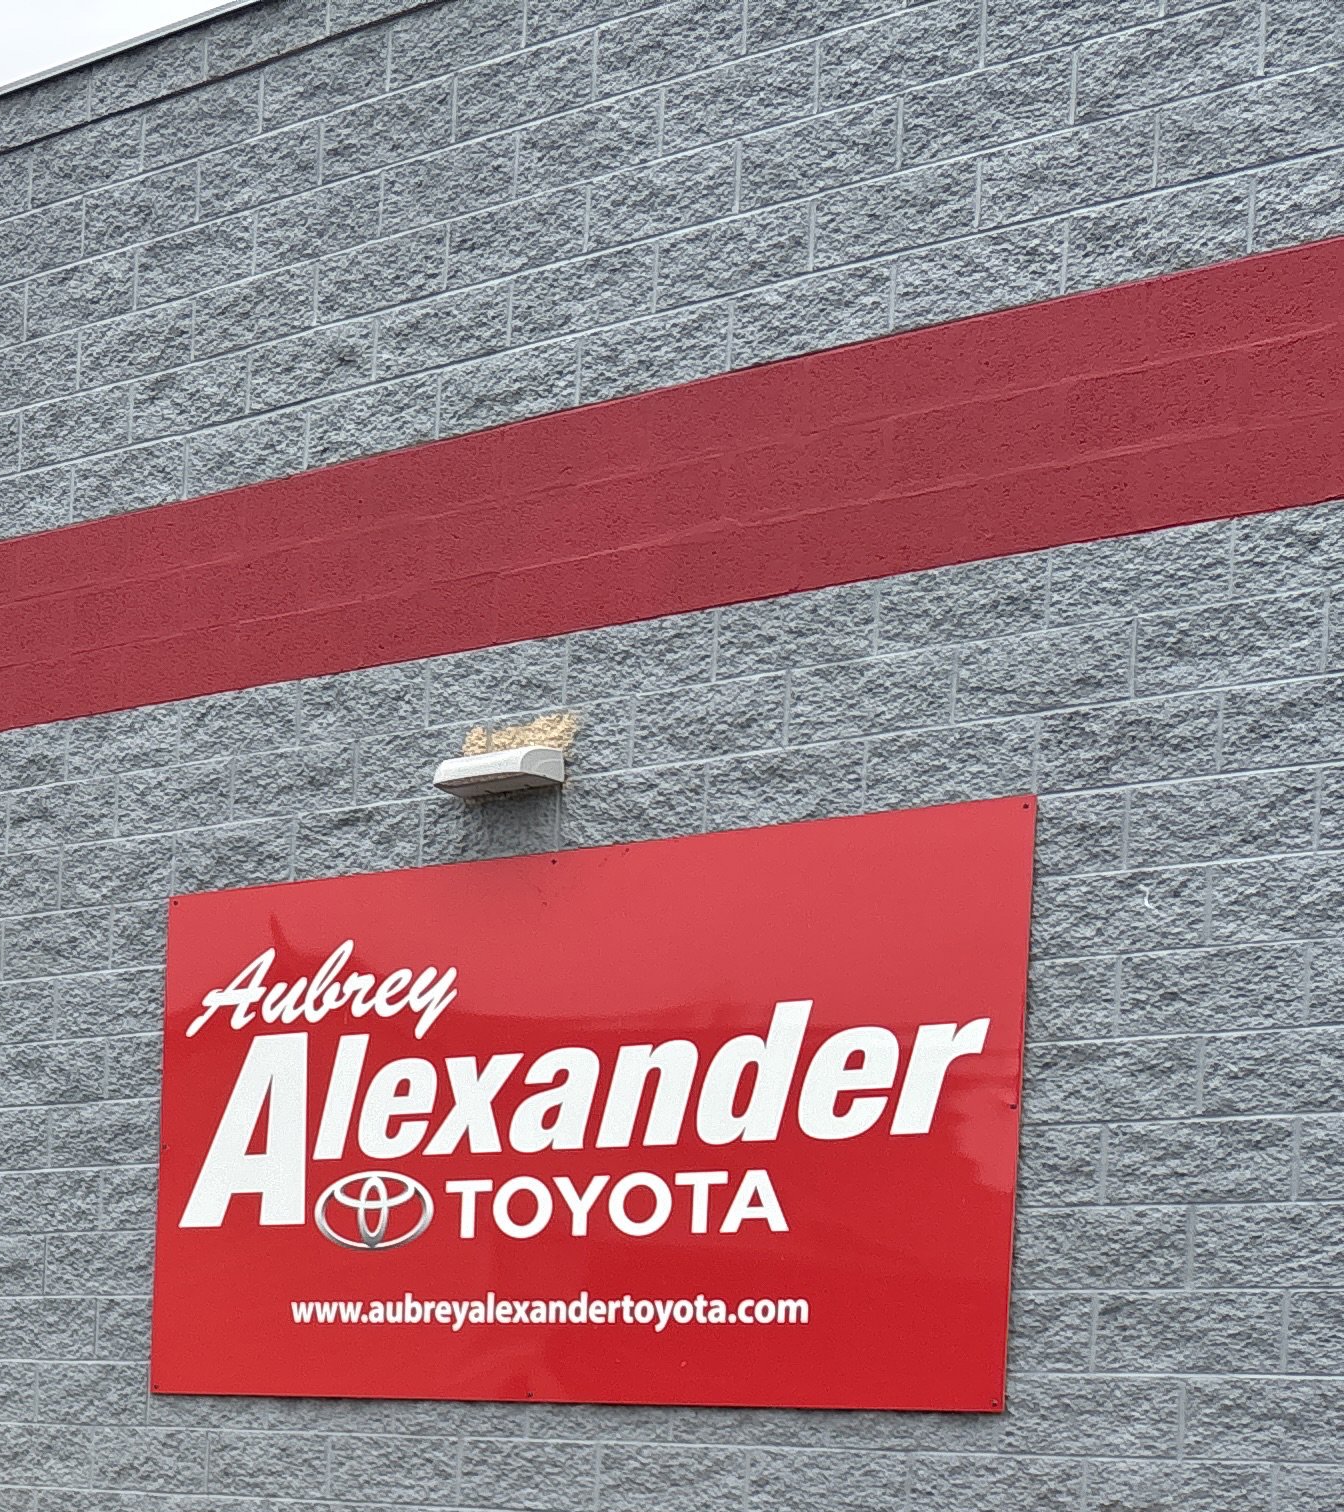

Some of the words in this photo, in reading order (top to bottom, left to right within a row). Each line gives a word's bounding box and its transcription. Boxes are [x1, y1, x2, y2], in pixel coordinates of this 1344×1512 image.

[185, 939, 459, 1040] Aubrey
[178, 999, 992, 1228] Alexander
[444, 1169, 790, 1239] TOYOTA
[290, 1291, 810, 1333] www.aubreyalexandertoyota.com
